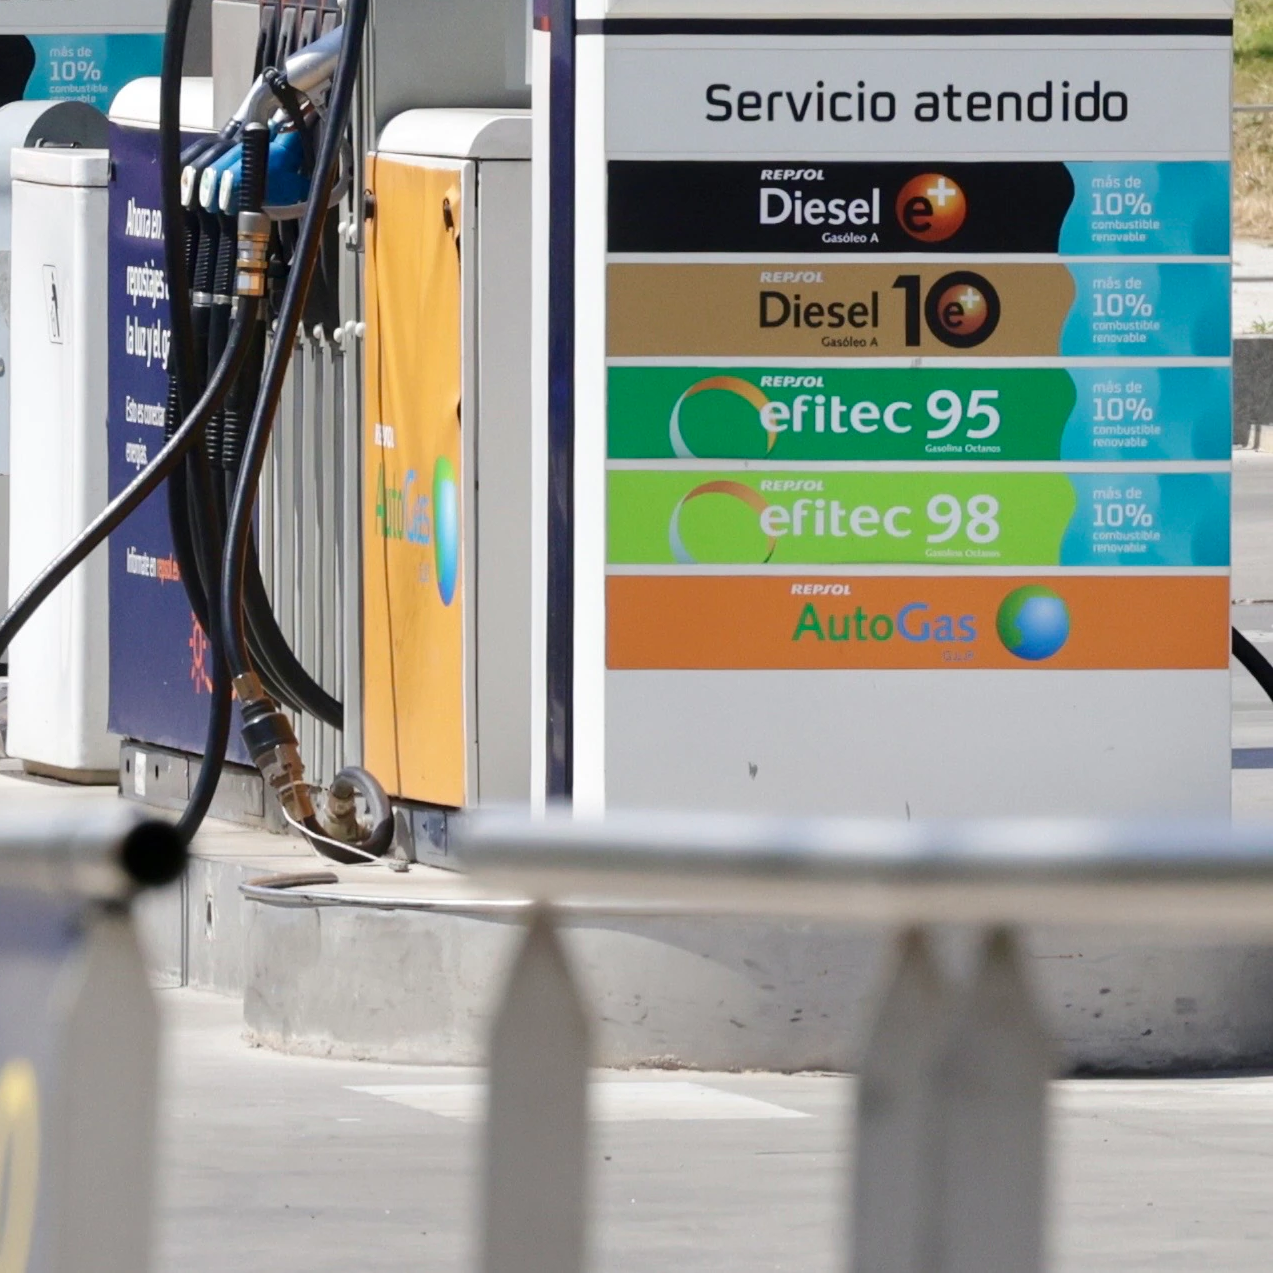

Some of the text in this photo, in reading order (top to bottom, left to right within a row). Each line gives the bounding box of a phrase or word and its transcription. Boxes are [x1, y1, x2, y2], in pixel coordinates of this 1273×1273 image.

[49, 45, 92, 57] más de
[50, 61, 101, 80] 10%
[705, 80, 1130, 123] Servicio atendido
[760, 169, 825, 180] REPSOL
[1091, 176, 1142, 189] más de
[759, 187, 881, 226] Diesel
[1091, 192, 1152, 217] 10%
[125, 197, 151, 238] Ahorra
[1091, 219, 1160, 231] combustible
[821, 232, 880, 244] Gasóleo A
[1091, 232, 1147, 243] renovable
[126, 258, 165, 309] repostajes
[760, 272, 824, 283] REPSOL
[1092, 277, 1142, 290] más de
[759, 291, 880, 329] Diesel
[1092, 293, 1153, 317] 10%
[1092, 320, 1160, 331] combustible
[821, 335, 879, 348] Gasóleo A
[1092, 332, 1147, 343] renovable
[760, 377, 825, 388] REPSOL
[1092, 381, 1143, 394] más de
[759, 389, 1001, 439] efitec 95
[1092, 397, 1153, 421] 10%
[1092, 424, 1161, 436] combustible
[1092, 436, 1148, 447] renovable
[925, 443, 963, 454] Gasolina
[760, 480, 824, 491] REPSOL
[1092, 487, 1143, 500] más de
[759, 494, 1001, 544] efitec 98
[1092, 503, 1153, 527] 10%
[1092, 529, 1161, 541] combustible
[1092, 541, 1147, 552] renovable
[791, 584, 852, 595] REPSOL
[791, 601, 977, 643] AutoGas
